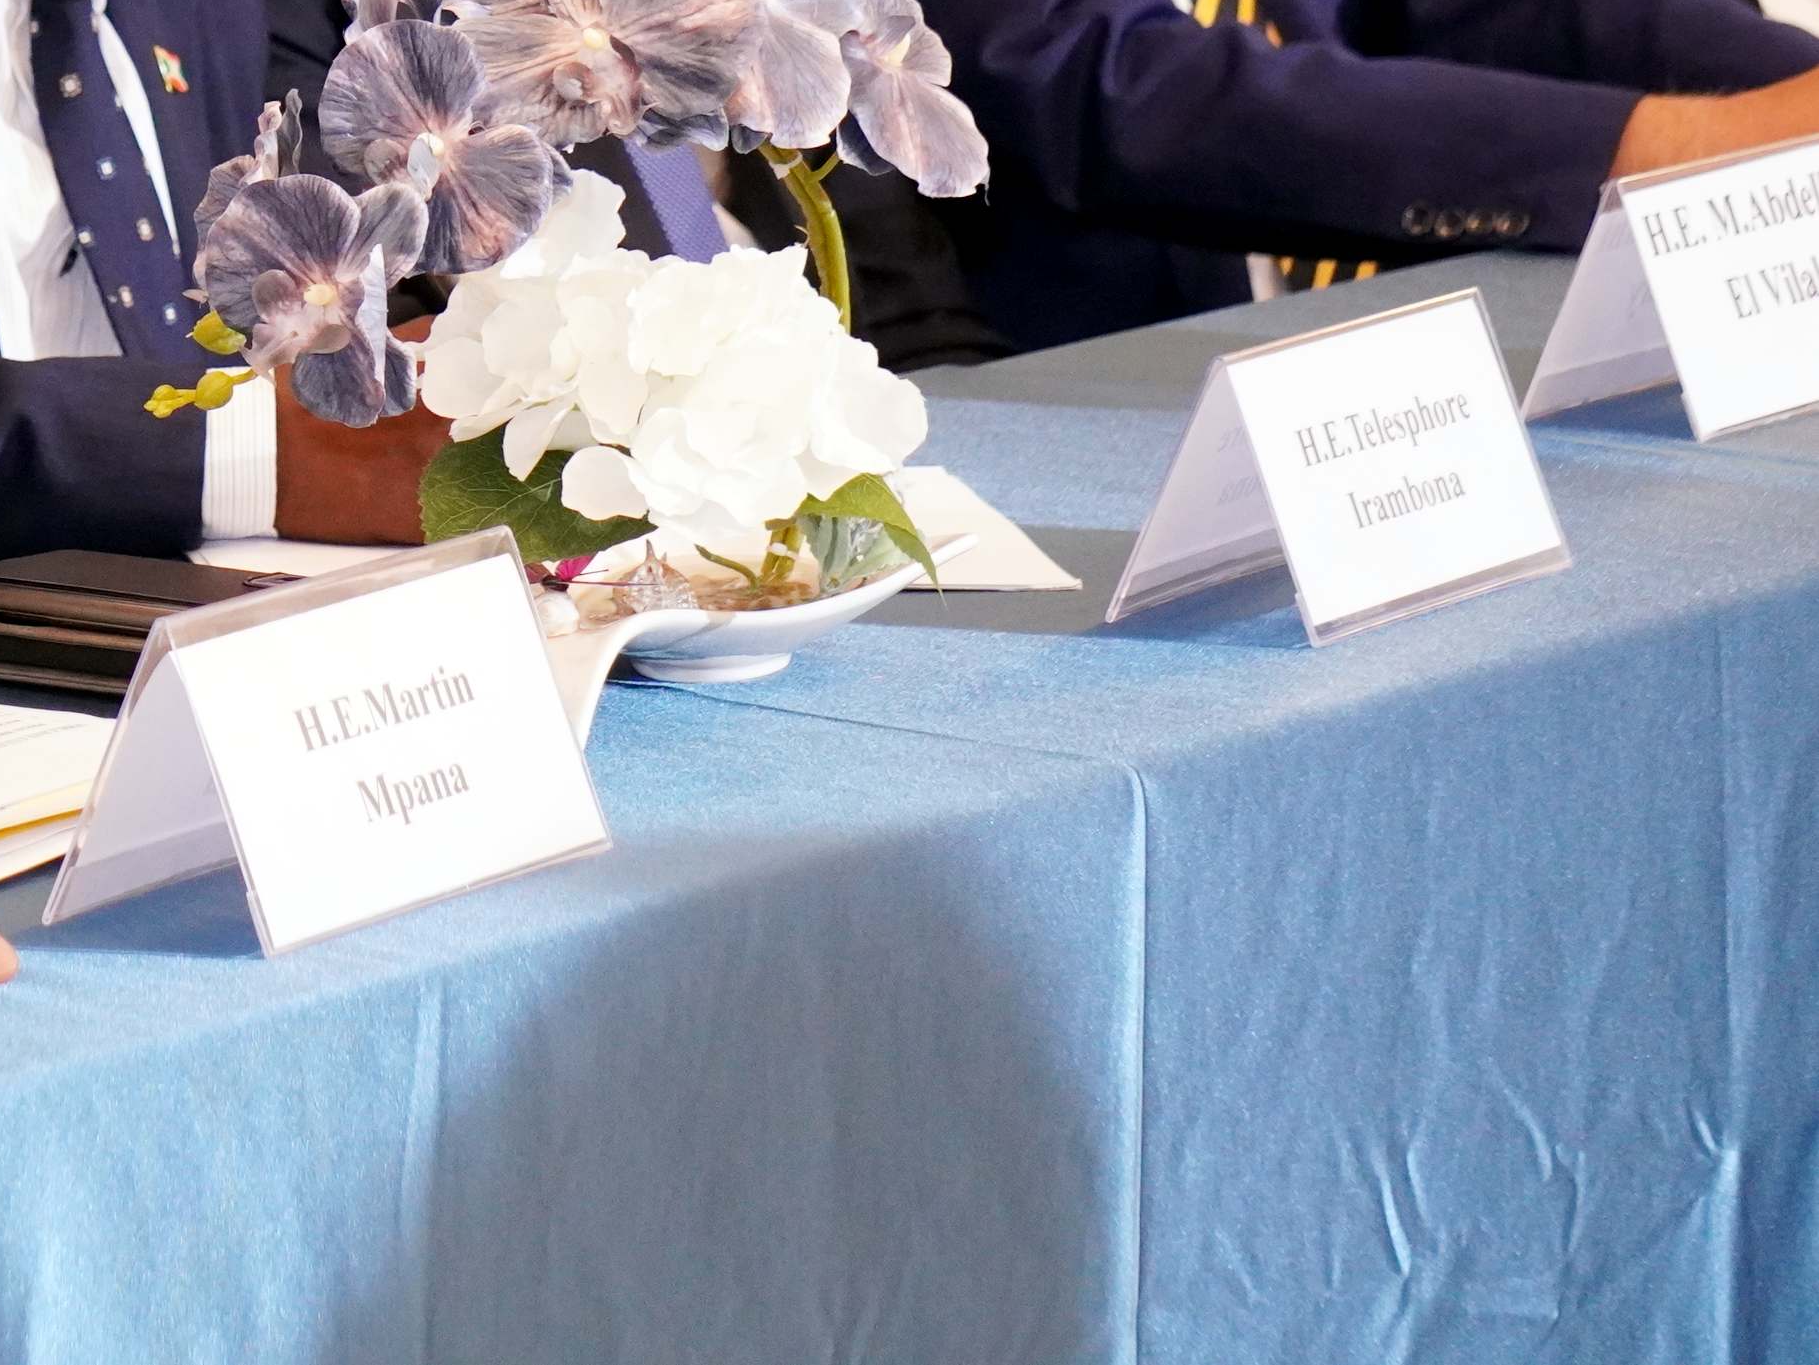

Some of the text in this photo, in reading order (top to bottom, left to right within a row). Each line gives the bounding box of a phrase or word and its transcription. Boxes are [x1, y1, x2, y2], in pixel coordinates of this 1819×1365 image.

[1643, 171, 1819, 256] H.E. M.Abdel
[1726, 272, 1761, 319] El
[1295, 391, 1471, 467] H.E.Telesphore
[1347, 470, 1467, 529] Irambona
[292, 665, 475, 752] H.E.Martin
[356, 762, 470, 825] Mpana
